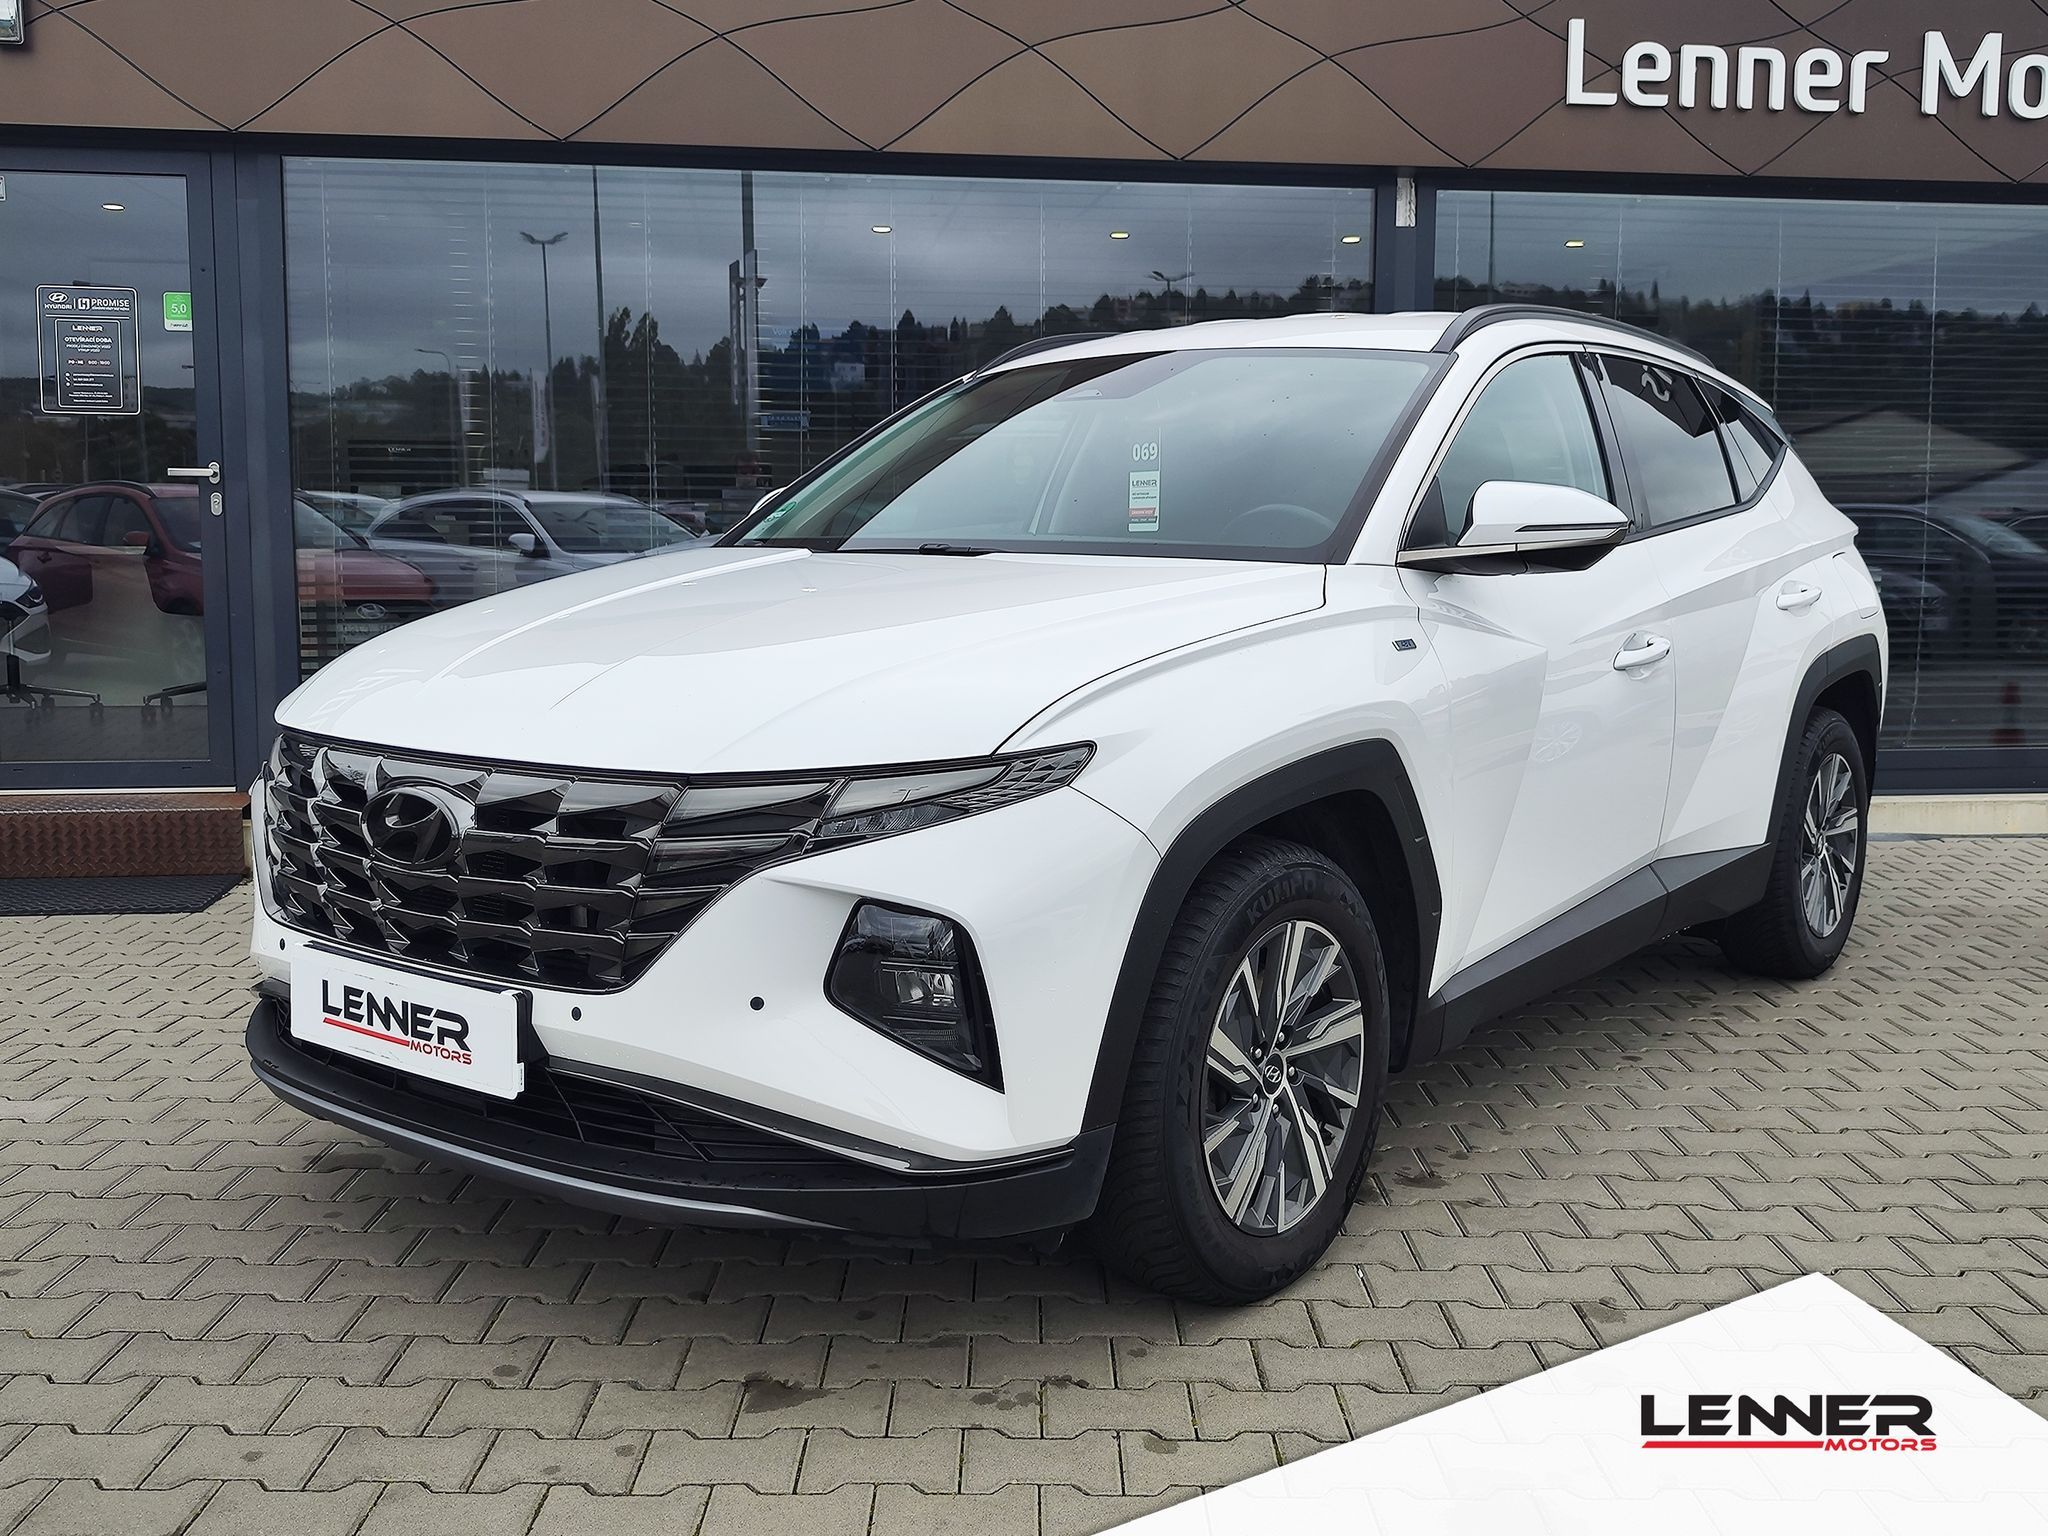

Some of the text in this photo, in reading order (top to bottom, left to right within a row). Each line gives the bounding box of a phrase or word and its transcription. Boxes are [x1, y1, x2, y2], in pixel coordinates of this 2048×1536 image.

[1566, 18, 2048, 121] Lenner Mo
[91, 299, 130, 307] PROMISE
[1132, 442, 1158, 461] 069
[321, 979, 472, 1053] LENNER
[410, 1039, 473, 1066] MOTORS
